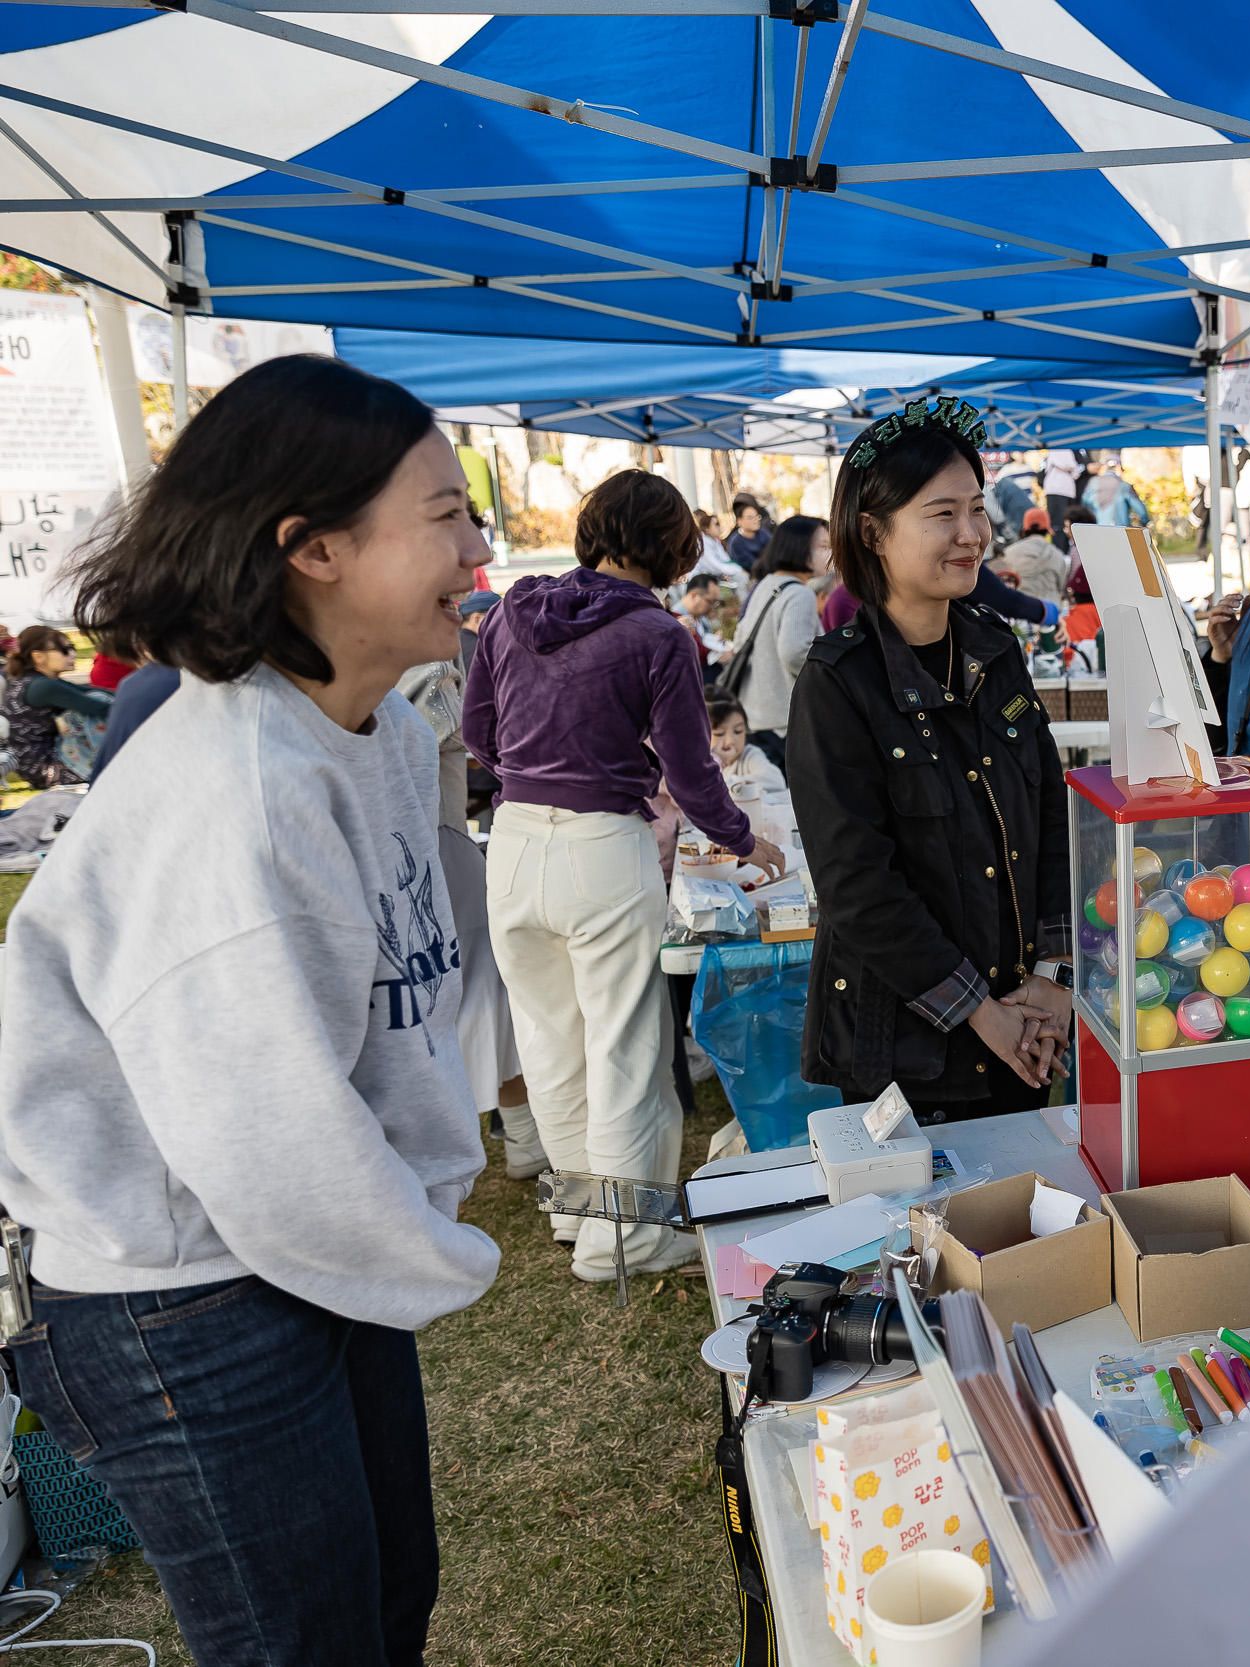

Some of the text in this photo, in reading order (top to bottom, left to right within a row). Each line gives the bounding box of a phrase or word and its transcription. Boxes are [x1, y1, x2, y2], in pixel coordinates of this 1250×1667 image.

[893, 1448, 919, 1470] POP
[914, 1475, 945, 1505] 팝콘
[899, 1521, 925, 1543] POP
